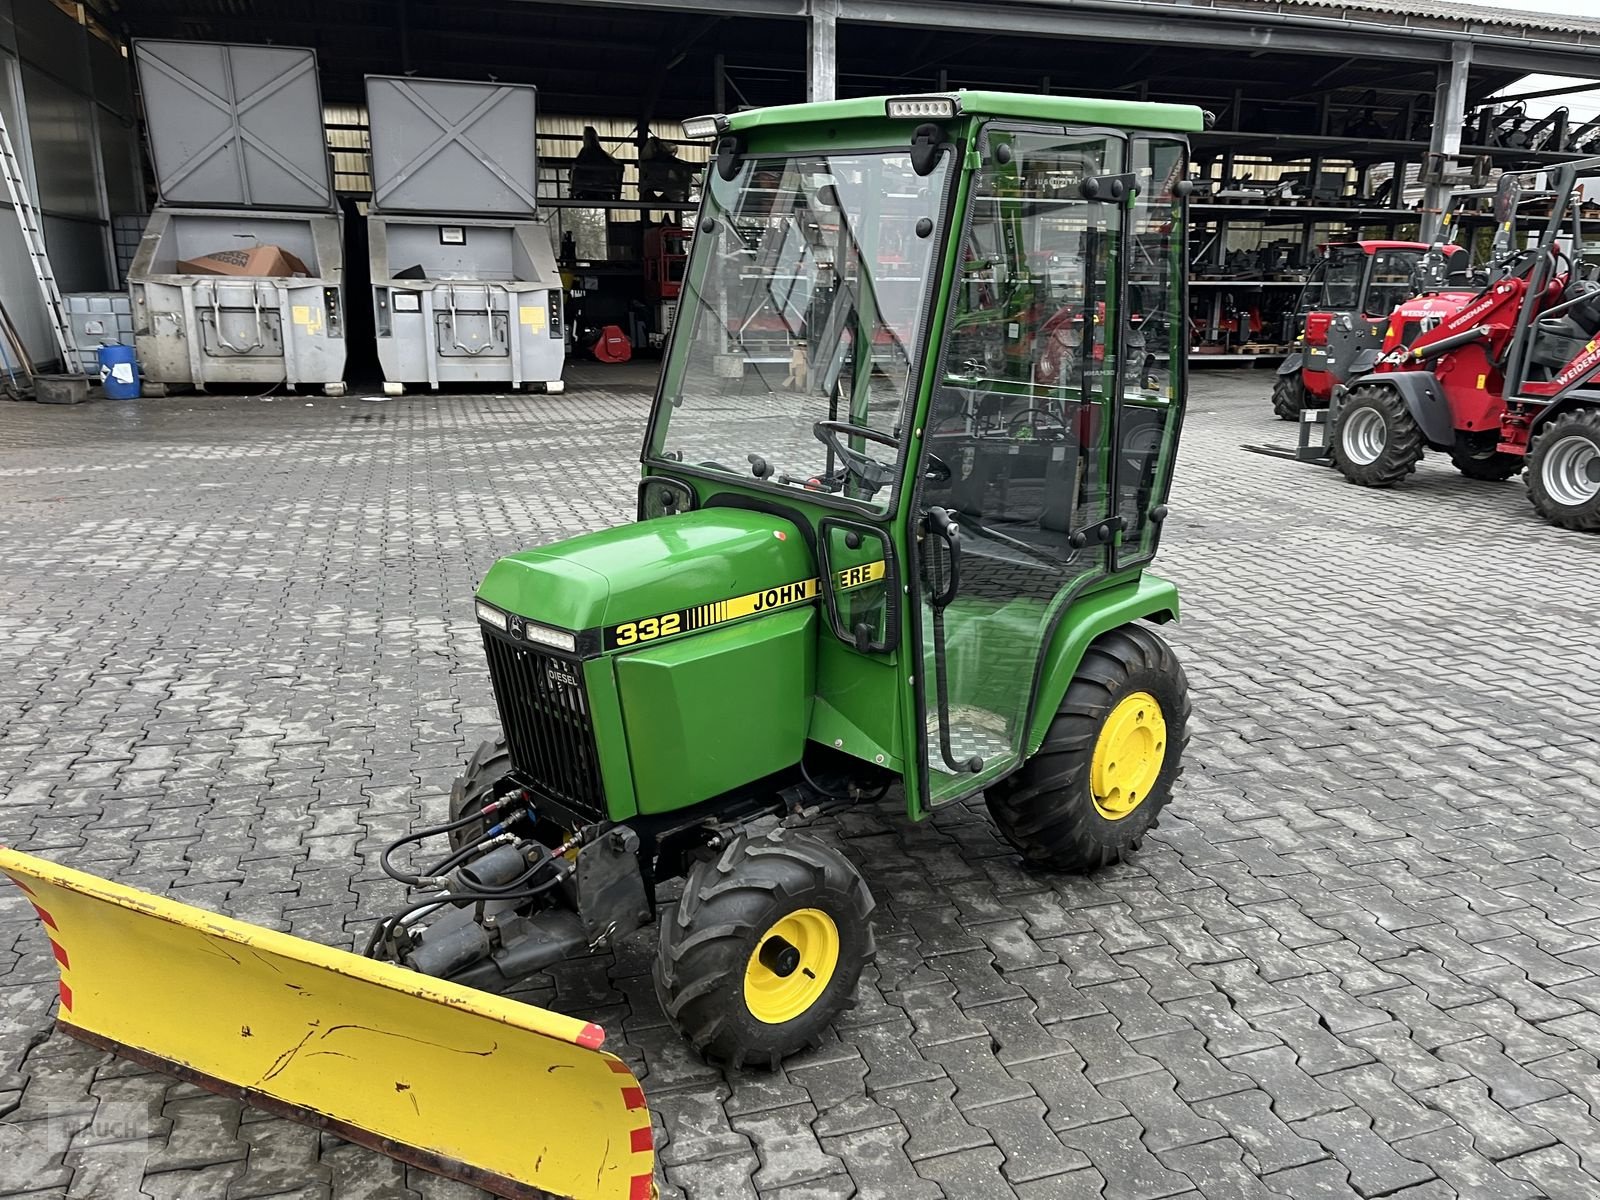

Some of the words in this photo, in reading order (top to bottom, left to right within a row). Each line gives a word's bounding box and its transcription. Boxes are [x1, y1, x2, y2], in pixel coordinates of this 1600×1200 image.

[1448, 299, 1494, 330] WEIDEMANN
[616, 613, 681, 646] 332
[753, 582, 806, 611] JOHN
[815, 565, 871, 597] DERE
[548, 670, 578, 686] DIESEL
